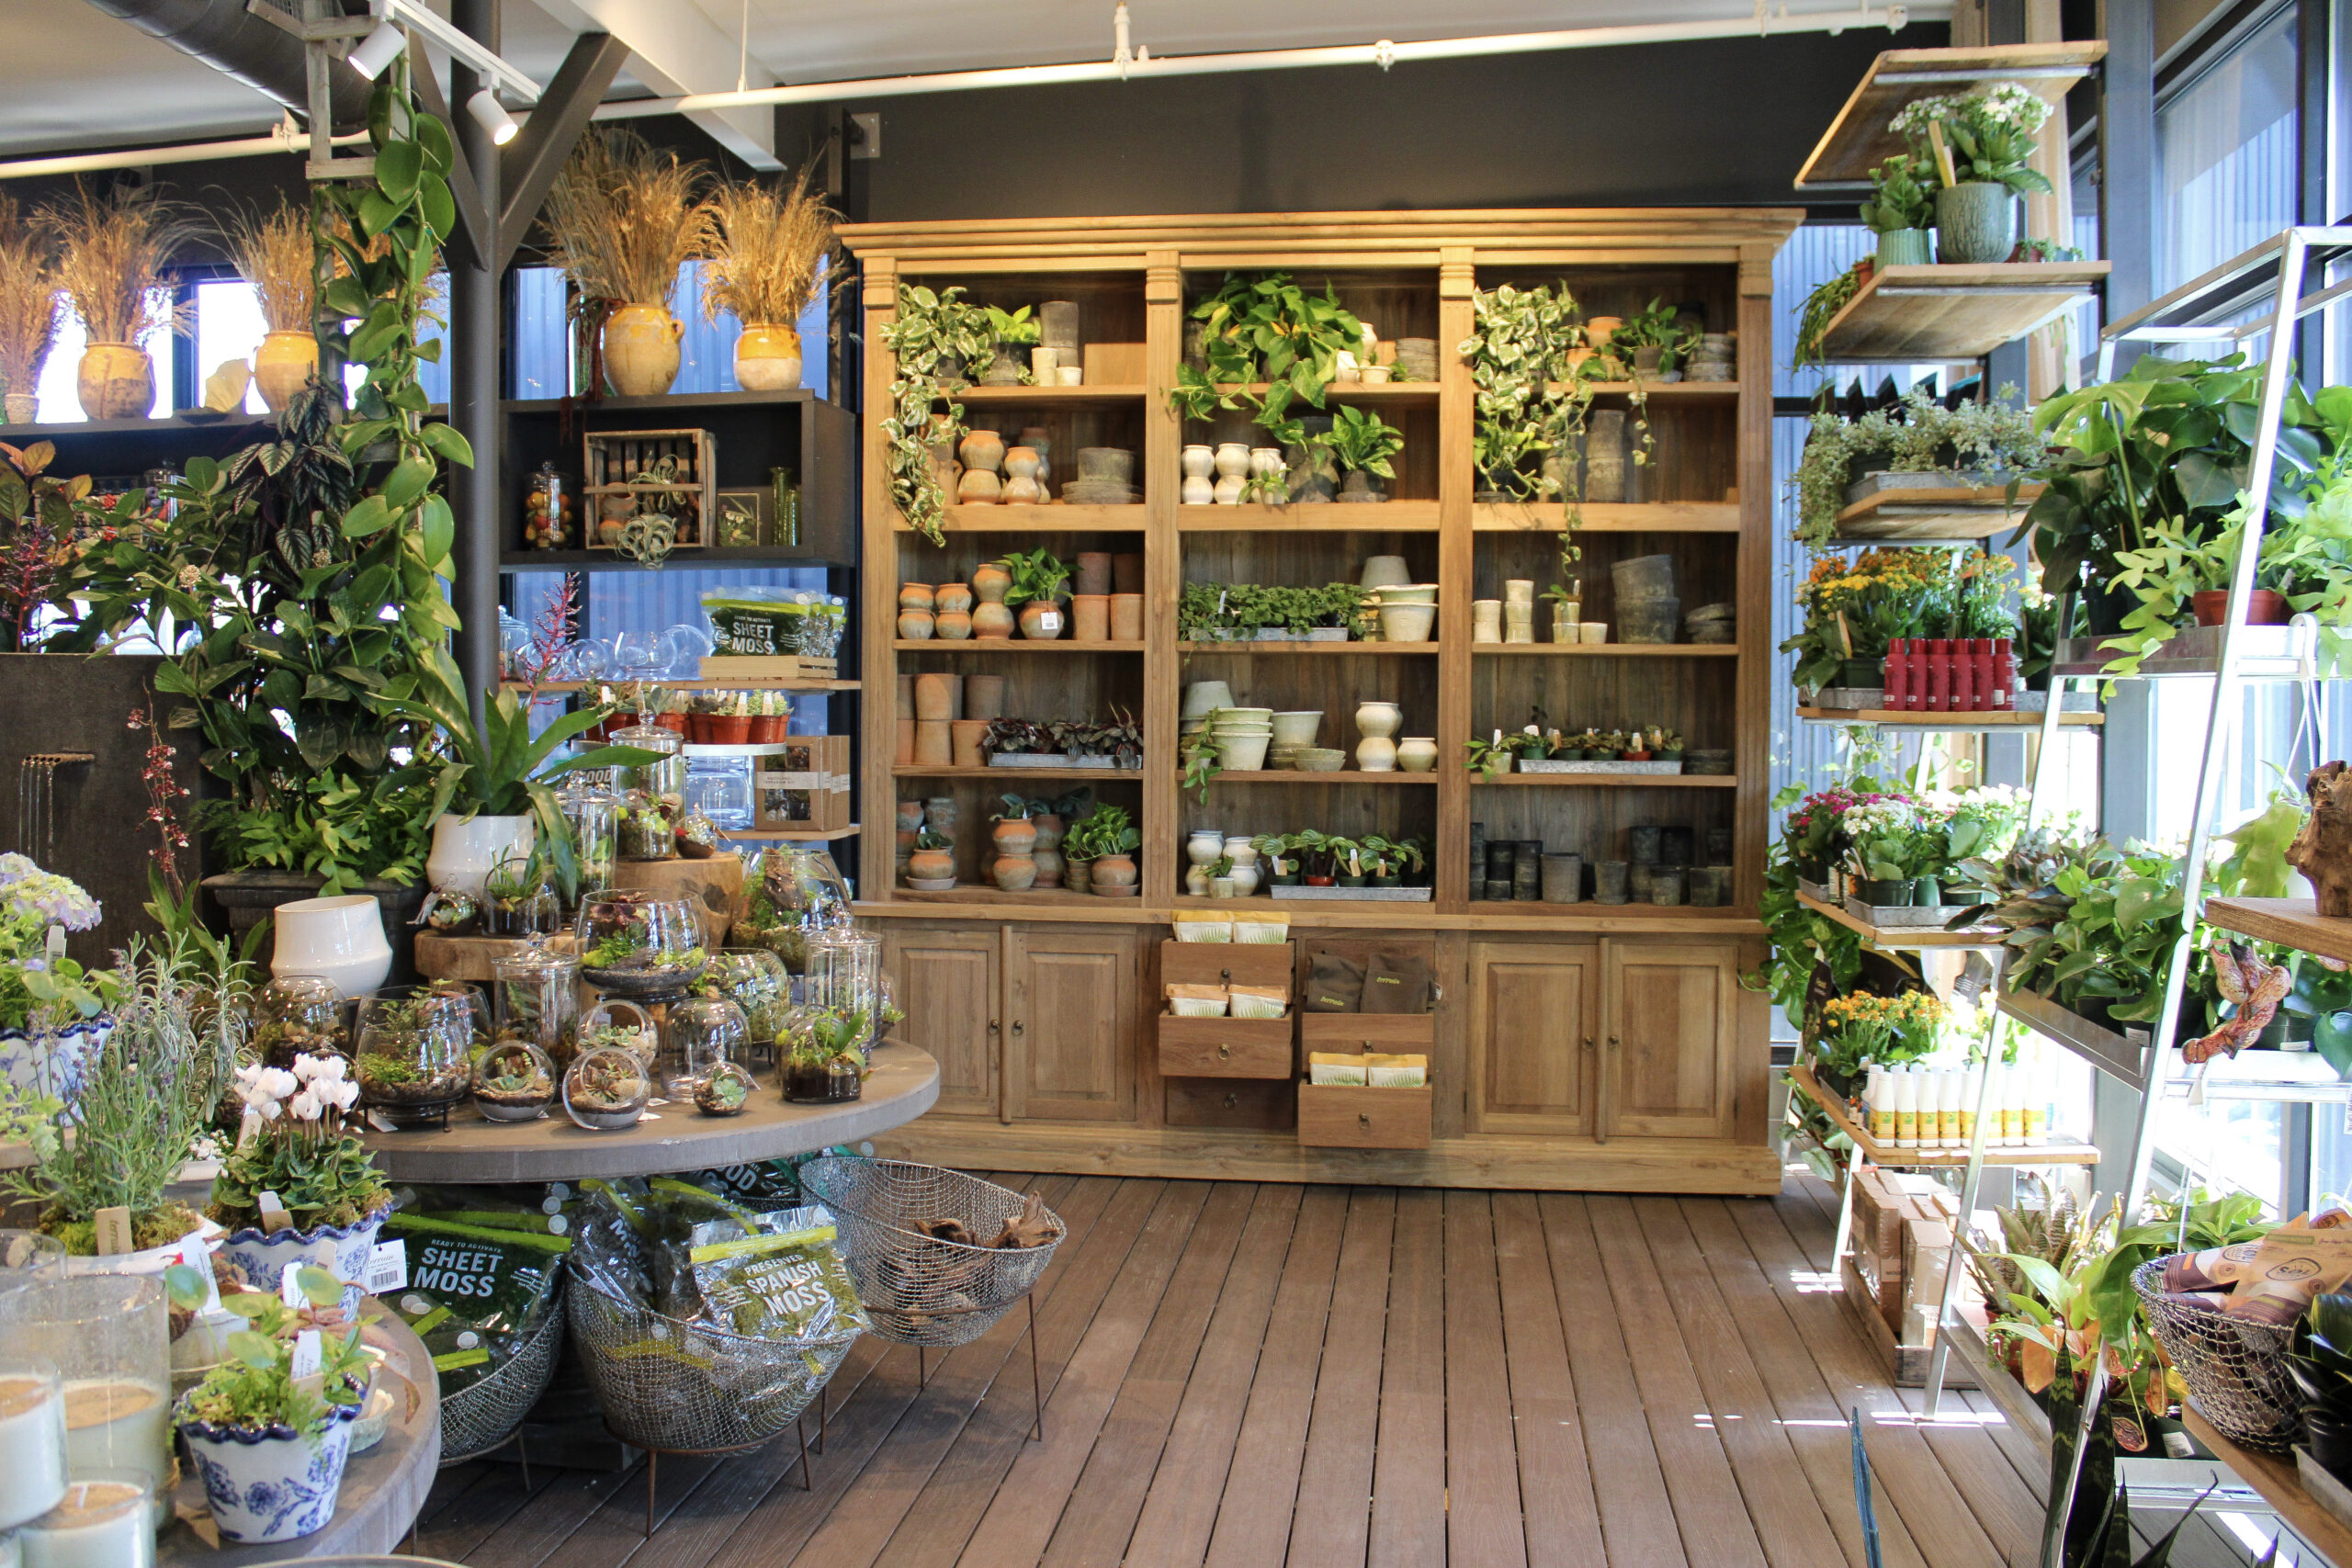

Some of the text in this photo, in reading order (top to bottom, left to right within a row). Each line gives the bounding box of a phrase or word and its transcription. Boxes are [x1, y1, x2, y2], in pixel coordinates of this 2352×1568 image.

[732, 622, 774, 640] SHEET
[731, 637, 774, 655] MOSS
[716, 1163, 757, 1190] OD
[431, 1239, 455, 1247] READY
[468, 1243, 503, 1253] ACTIVATE
[421, 1247, 503, 1273] SHEET
[744, 1254, 804, 1276] PRESERVED
[413, 1266, 496, 1297] MOSS
[746, 1260, 824, 1294] SPANISH
[763, 1280, 831, 1316] MOSS
